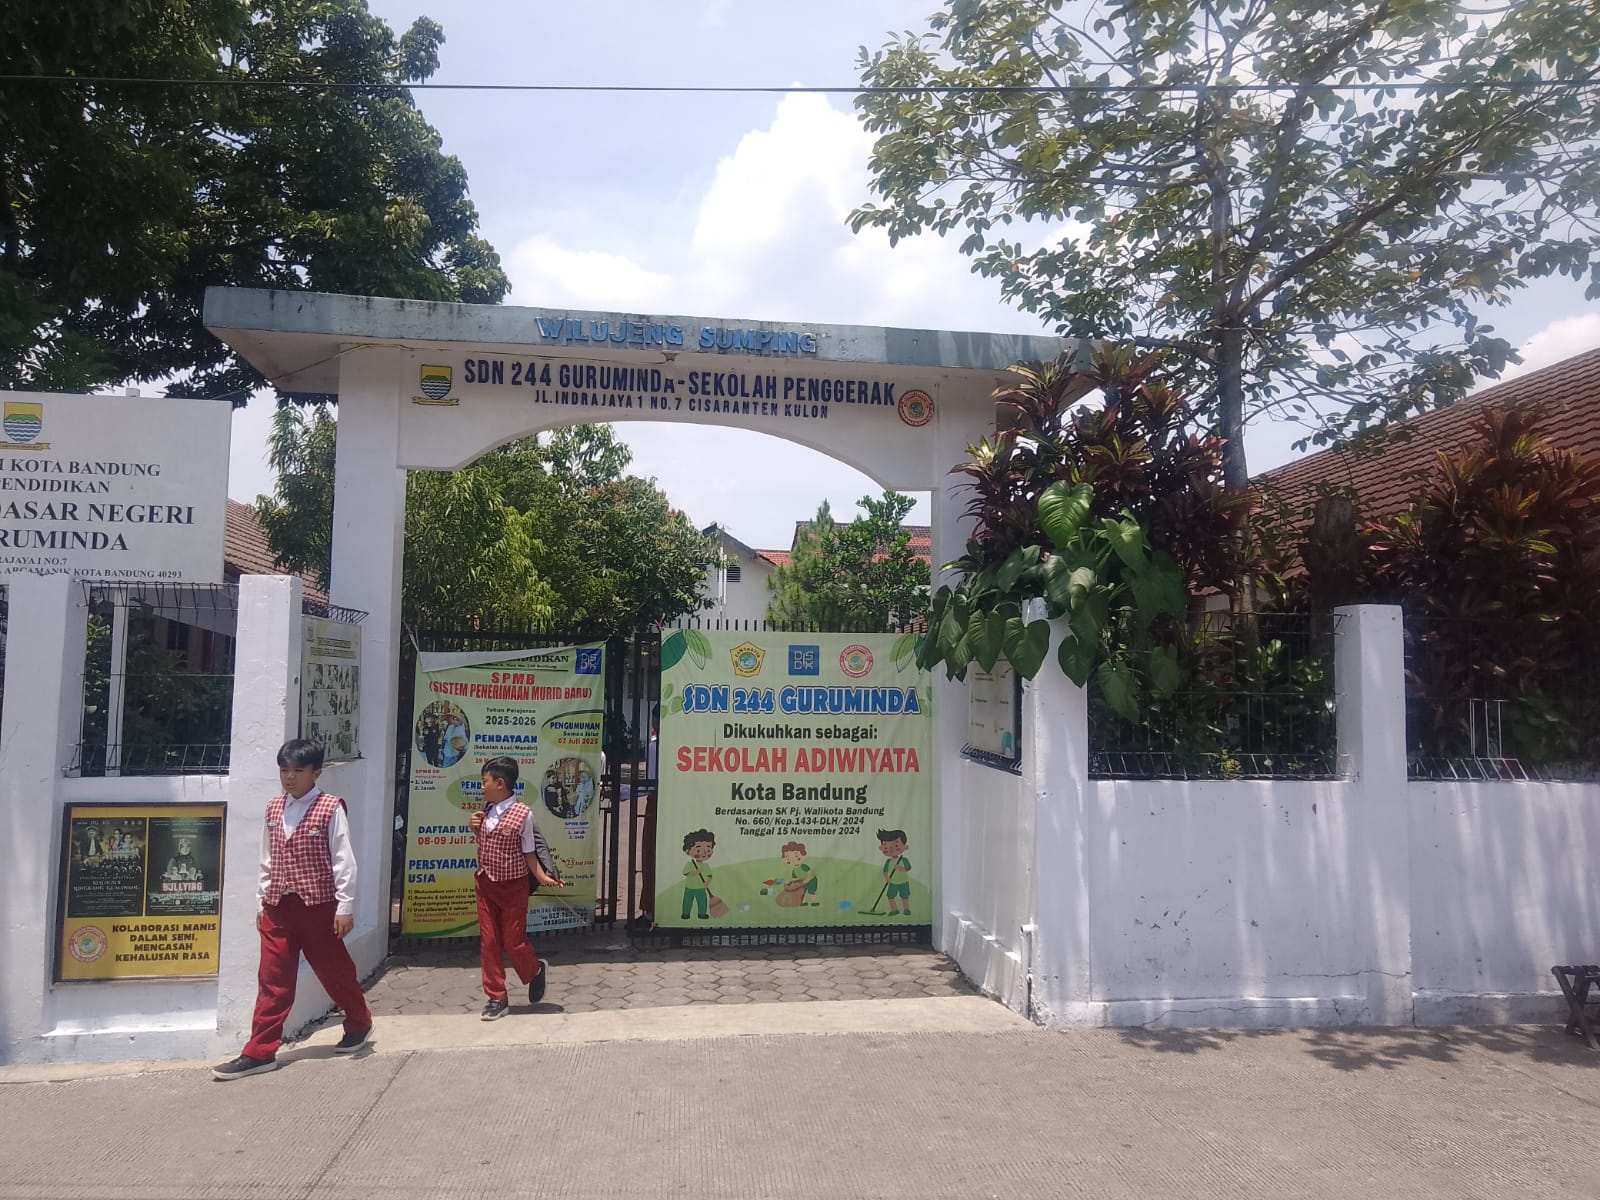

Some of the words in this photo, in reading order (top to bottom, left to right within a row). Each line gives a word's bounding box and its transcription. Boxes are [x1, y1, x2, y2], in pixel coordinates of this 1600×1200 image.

[535, 317, 683, 346] WILUJENG
[699, 326, 817, 352] SUMPING
[464, 359, 504, 385] SDN
[511, 361, 552, 386] 244
[783, 377, 895, 406] PENGGERAK
[688, 398, 778, 417] CISARANTEN
[784, 404, 828, 419] KULON
[10, 458, 64, 473] KOTA
[69, 461, 161, 477] BANDUNG
[0, 477, 111, 493] ENDIDIKAN
[0, 500, 79, 521] ASAR
[87, 503, 196, 525] NEGERI
[73, 568, 102, 577] KOTA
[104, 568, 155, 578] BANDUNG
[157, 570, 182, 579] 40293
[491, 671, 536, 685] SPMB
[428, 680, 468, 698] (SISTEM
[469, 683, 529, 701] PENERIMAAN
[531, 686, 562, 700] MURID
[564, 687, 592, 700] BARU)
[682, 684, 730, 714] SDN
[733, 686, 775, 714] 244
[779, 685, 921, 715] GURUMINDA
[485, 715, 536, 726] 2025-2026
[723, 723, 811, 740] Dikukuhkan
[815, 724, 878, 742] sebagai:
[676, 746, 787, 773] SEKOLAH
[794, 747, 920, 773] ADIWIYATA
[731, 783, 776, 801] Kota
[782, 783, 868, 804] Bandung
[715, 807, 773, 816] Berdasarkan
[775, 807, 787, 816] SK
[789, 808, 801, 817] Pj.
[804, 807, 844, 816] Walikota
[845, 807, 885, 816] Bandung
[735, 818, 750, 826] No.
[418, 825, 456, 834] DAFTAR
[739, 826, 775, 837] Tanggal
[776, 826, 789, 836] 15
[790, 827, 836, 836] November
[838, 826, 861, 836] 2024
[417, 836, 447, 845] 08-09
[448, 836, 467, 844] Juli
[408, 874, 436, 883] USIA
[162, 882, 203, 892] BULLYING
[112, 924, 179, 933] KOLABORASI
[182, 923, 217, 932] MANIS
[130, 933, 168, 942] DALAM
[115, 953, 179, 962] KEHALUSAN
[182, 952, 210, 960] RASA
